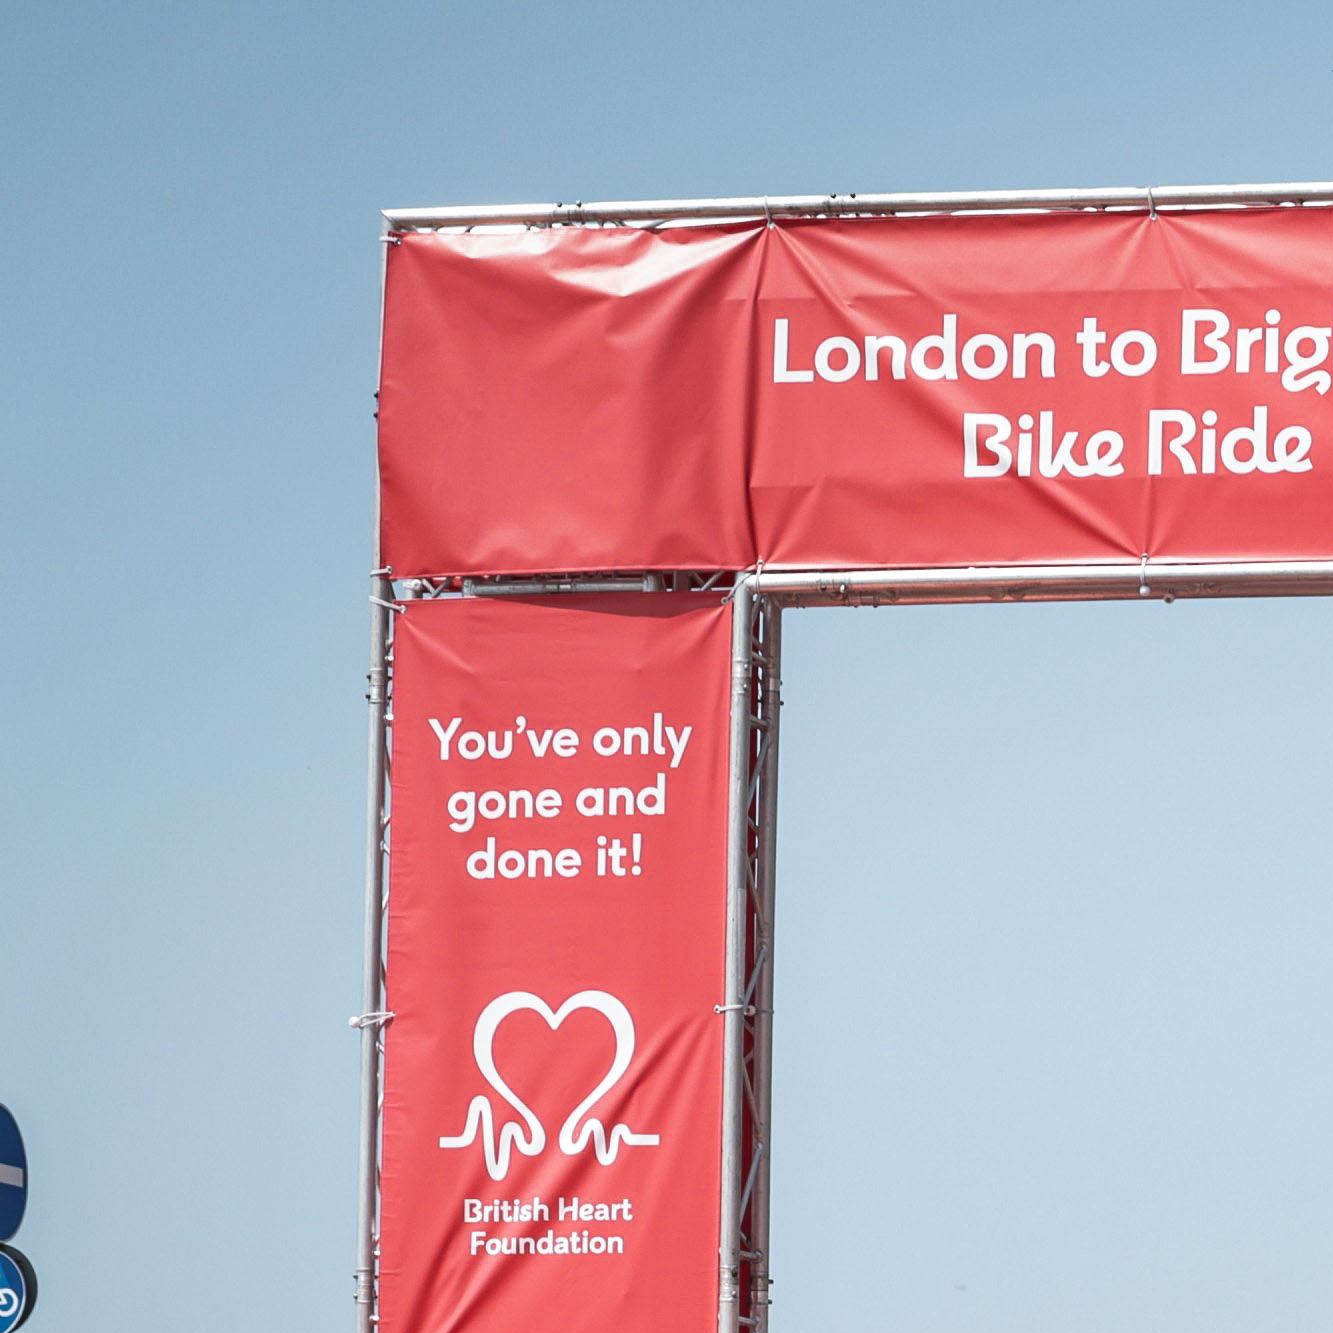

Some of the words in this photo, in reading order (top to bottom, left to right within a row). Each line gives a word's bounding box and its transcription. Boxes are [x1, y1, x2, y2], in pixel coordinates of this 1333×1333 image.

[773, 313, 1056, 385] London
[1075, 317, 1158, 378] to
[963, 410, 1126, 478] Bike
[1147, 405, 1313, 475] Ride
[428, 715, 580, 761] You've
[592, 712, 694, 768] only
[446, 788, 563, 834] gone
[575, 772, 667, 817] and
[466, 836, 582, 880] done
[596, 833, 643, 877] it!
[463, 1196, 549, 1223] British
[558, 1196, 633, 1222] Heart
[469, 1229, 624, 1256] Foundation
